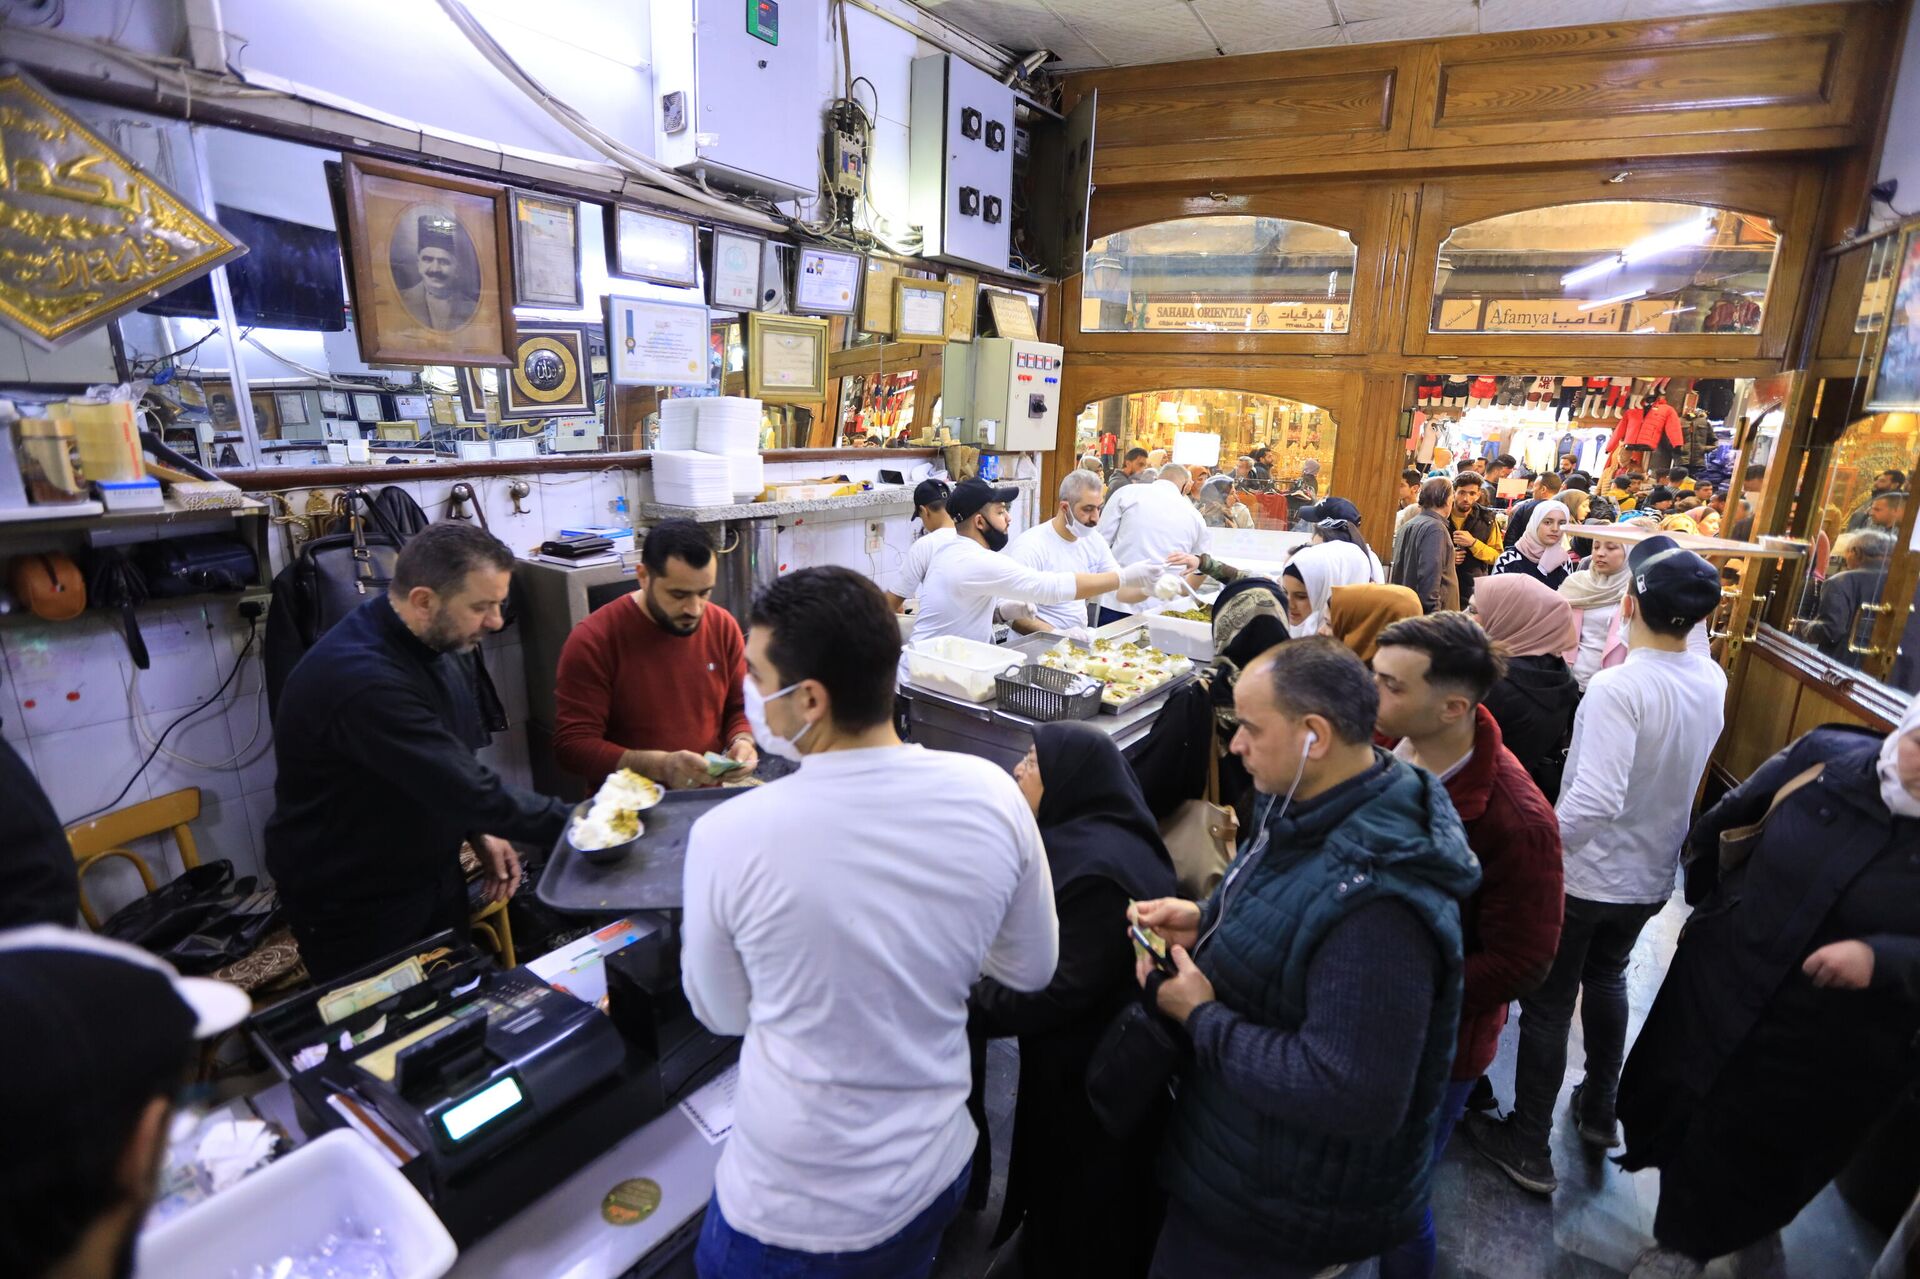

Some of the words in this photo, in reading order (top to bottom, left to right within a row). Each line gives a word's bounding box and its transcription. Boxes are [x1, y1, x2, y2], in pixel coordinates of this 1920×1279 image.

[1156, 306, 1195, 318] SAHARA
[1197, 306, 1252, 319] ORIENTALS
[1489, 308, 1549, 328] Afamya
[1551, 308, 1616, 328] أفاميا
